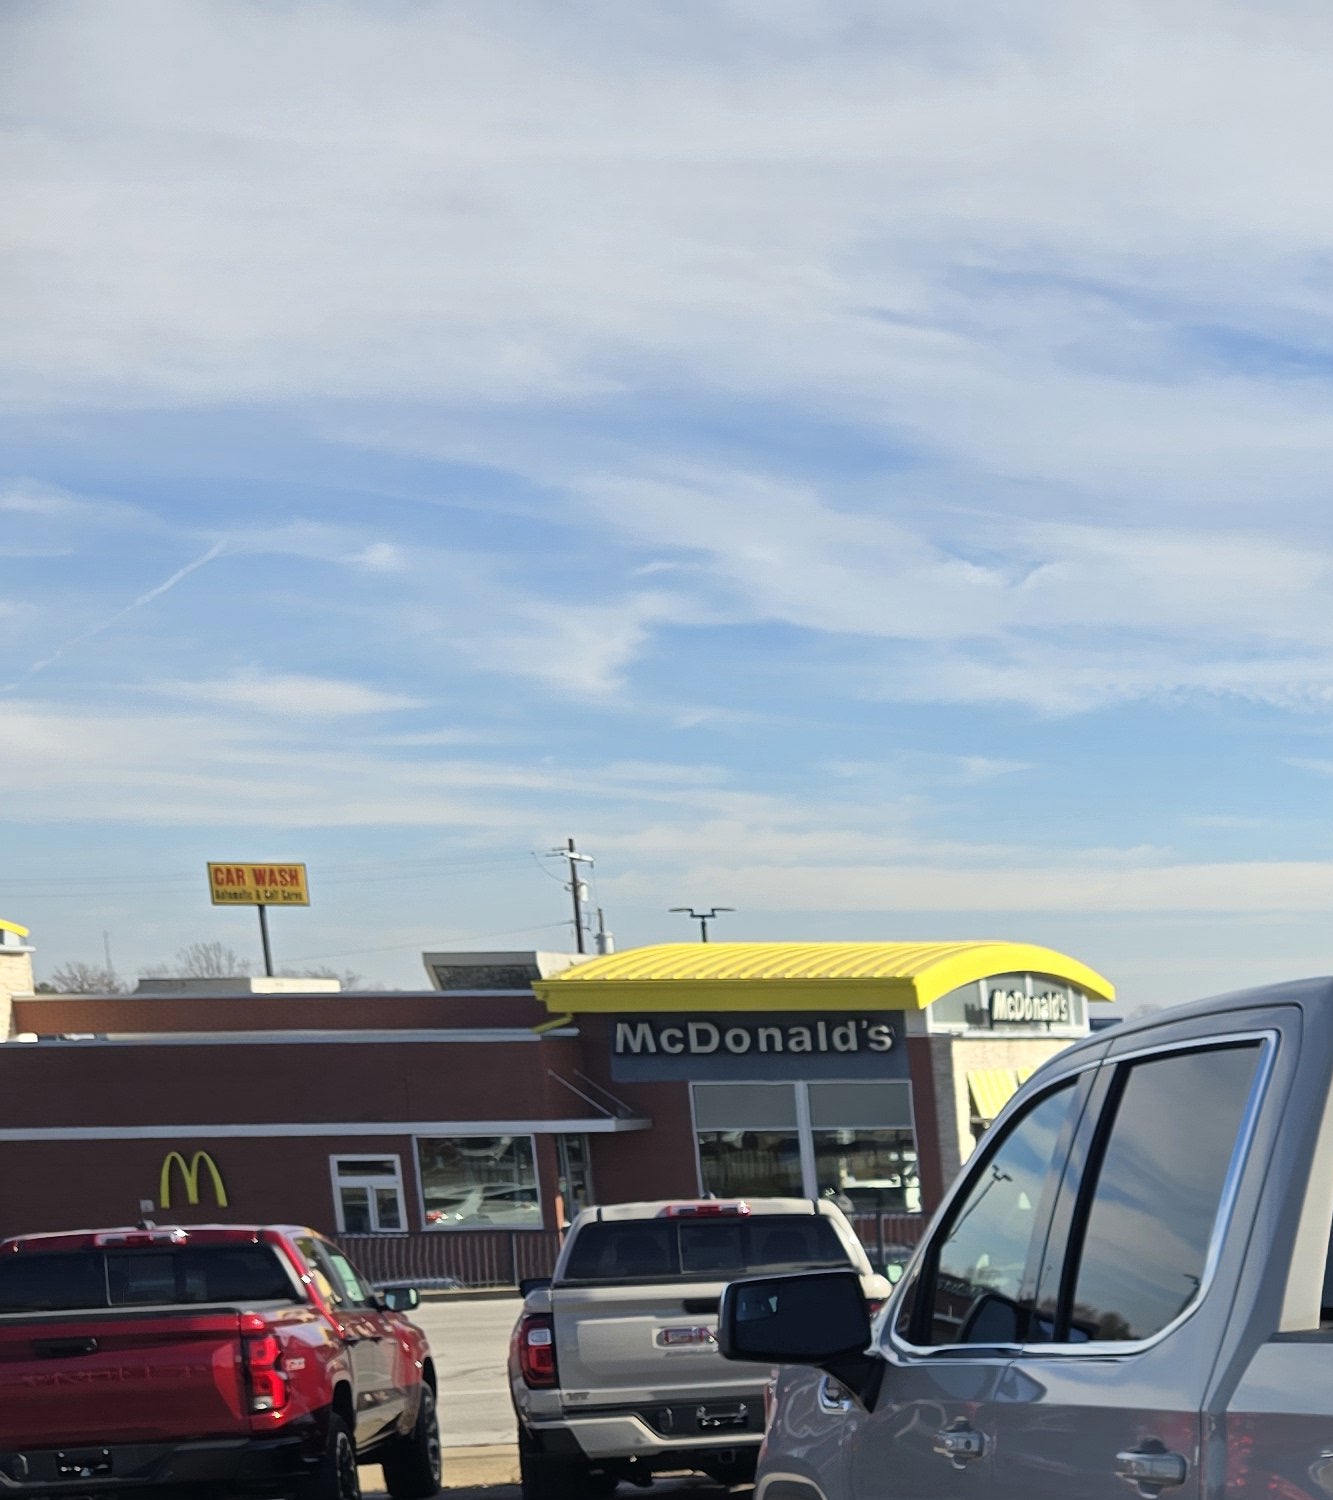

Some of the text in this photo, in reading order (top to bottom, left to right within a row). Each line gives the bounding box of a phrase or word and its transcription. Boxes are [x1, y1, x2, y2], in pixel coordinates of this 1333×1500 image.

[213, 867, 299, 887] CAR WASH
[991, 989, 1069, 1023] McDonald's
[614, 1019, 896, 1055] McDonald's
